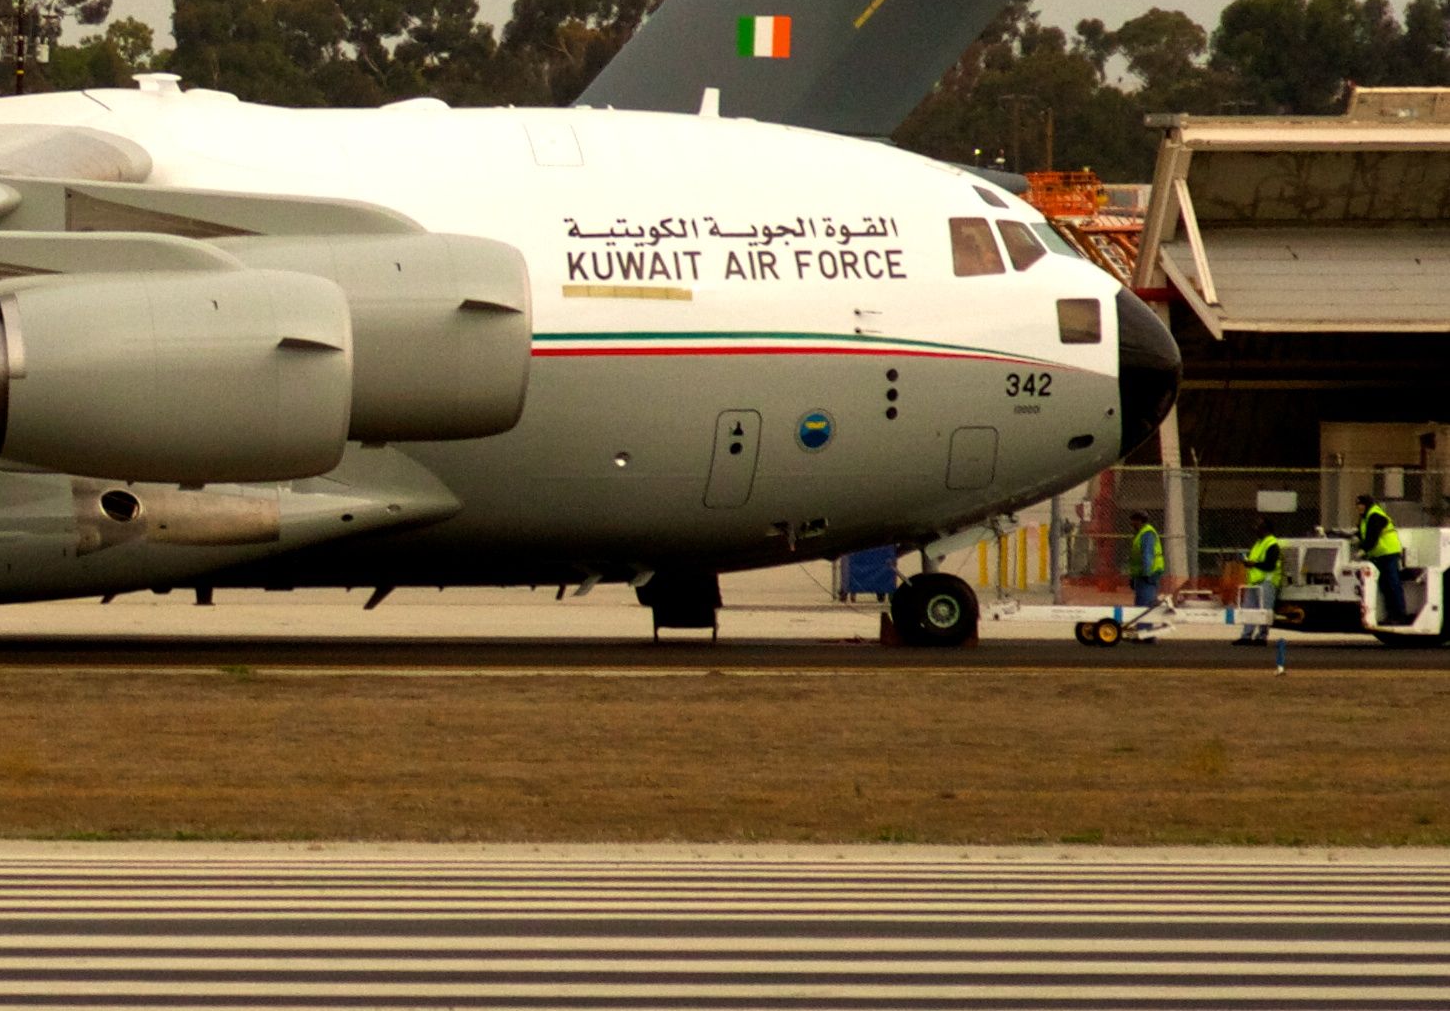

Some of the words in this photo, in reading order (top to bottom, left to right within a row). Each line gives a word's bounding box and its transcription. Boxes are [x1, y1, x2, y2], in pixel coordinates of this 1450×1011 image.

[563, 217, 699, 248] الكويتية
[702, 216, 817, 248] الجوية
[821, 216, 899, 246] القوة
[566, 251, 702, 281] KUWAIT
[724, 251, 781, 281] AIR
[794, 250, 908, 280] FORCE
[1005, 372, 1053, 398] 342
